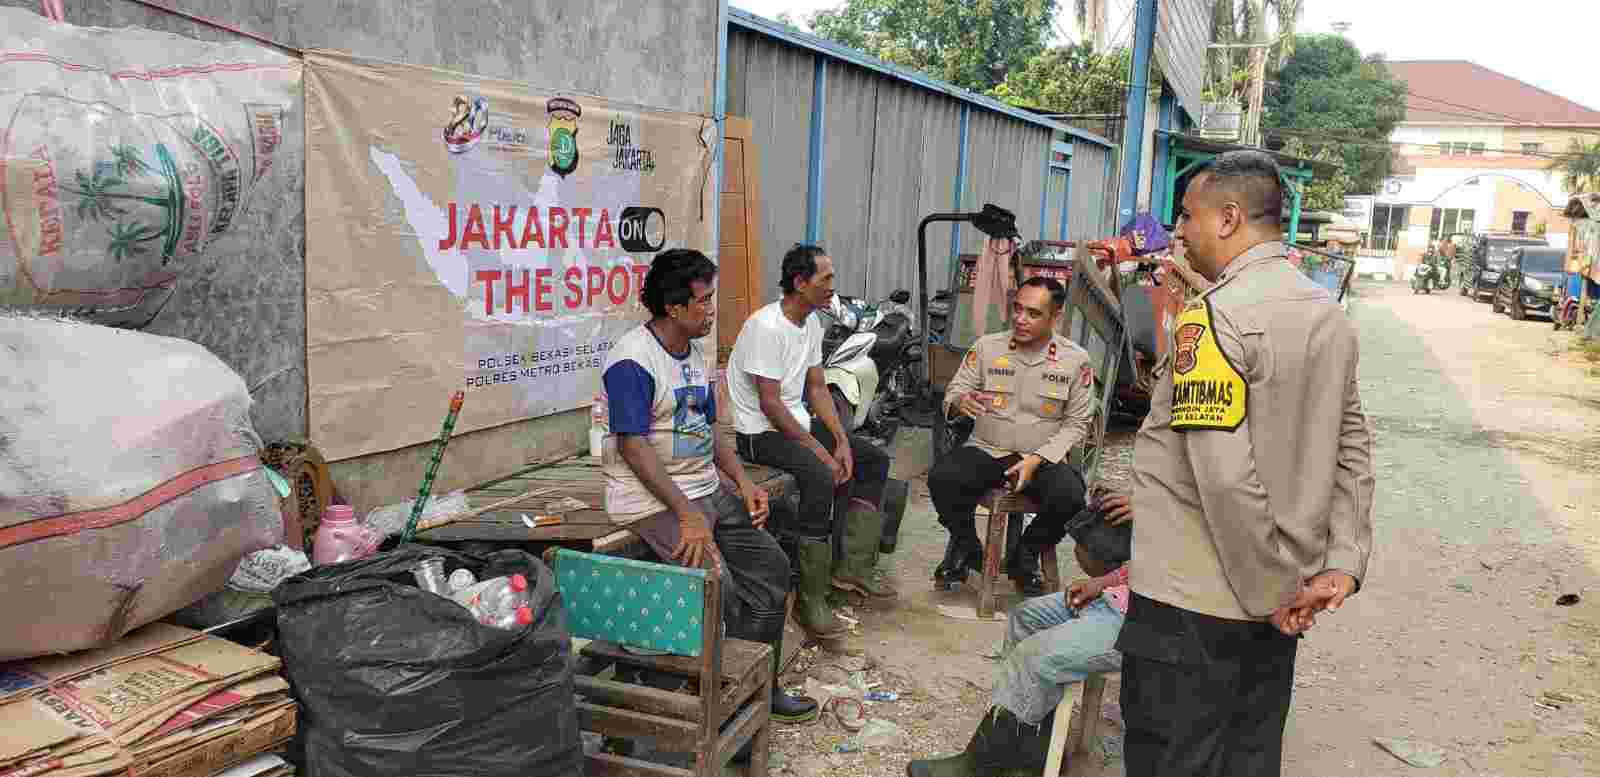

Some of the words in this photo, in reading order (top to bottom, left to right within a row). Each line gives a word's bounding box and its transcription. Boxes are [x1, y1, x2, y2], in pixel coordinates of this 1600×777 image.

[607, 119, 631, 145] JAGA
[438, 202, 617, 250] JAKARTA
[621, 219, 643, 240] ON
[476, 267, 553, 315] THE
[563, 264, 650, 308] SPOT
[478, 353, 527, 369] POLSEK
[531, 347, 571, 362] BEKAS
[576, 341, 616, 356] SELATA
[466, 370, 517, 387] POLRES
[520, 364, 560, 378] METRO
[563, 357, 602, 372] BEKAS
[1040, 371, 1070, 384] POLRI
